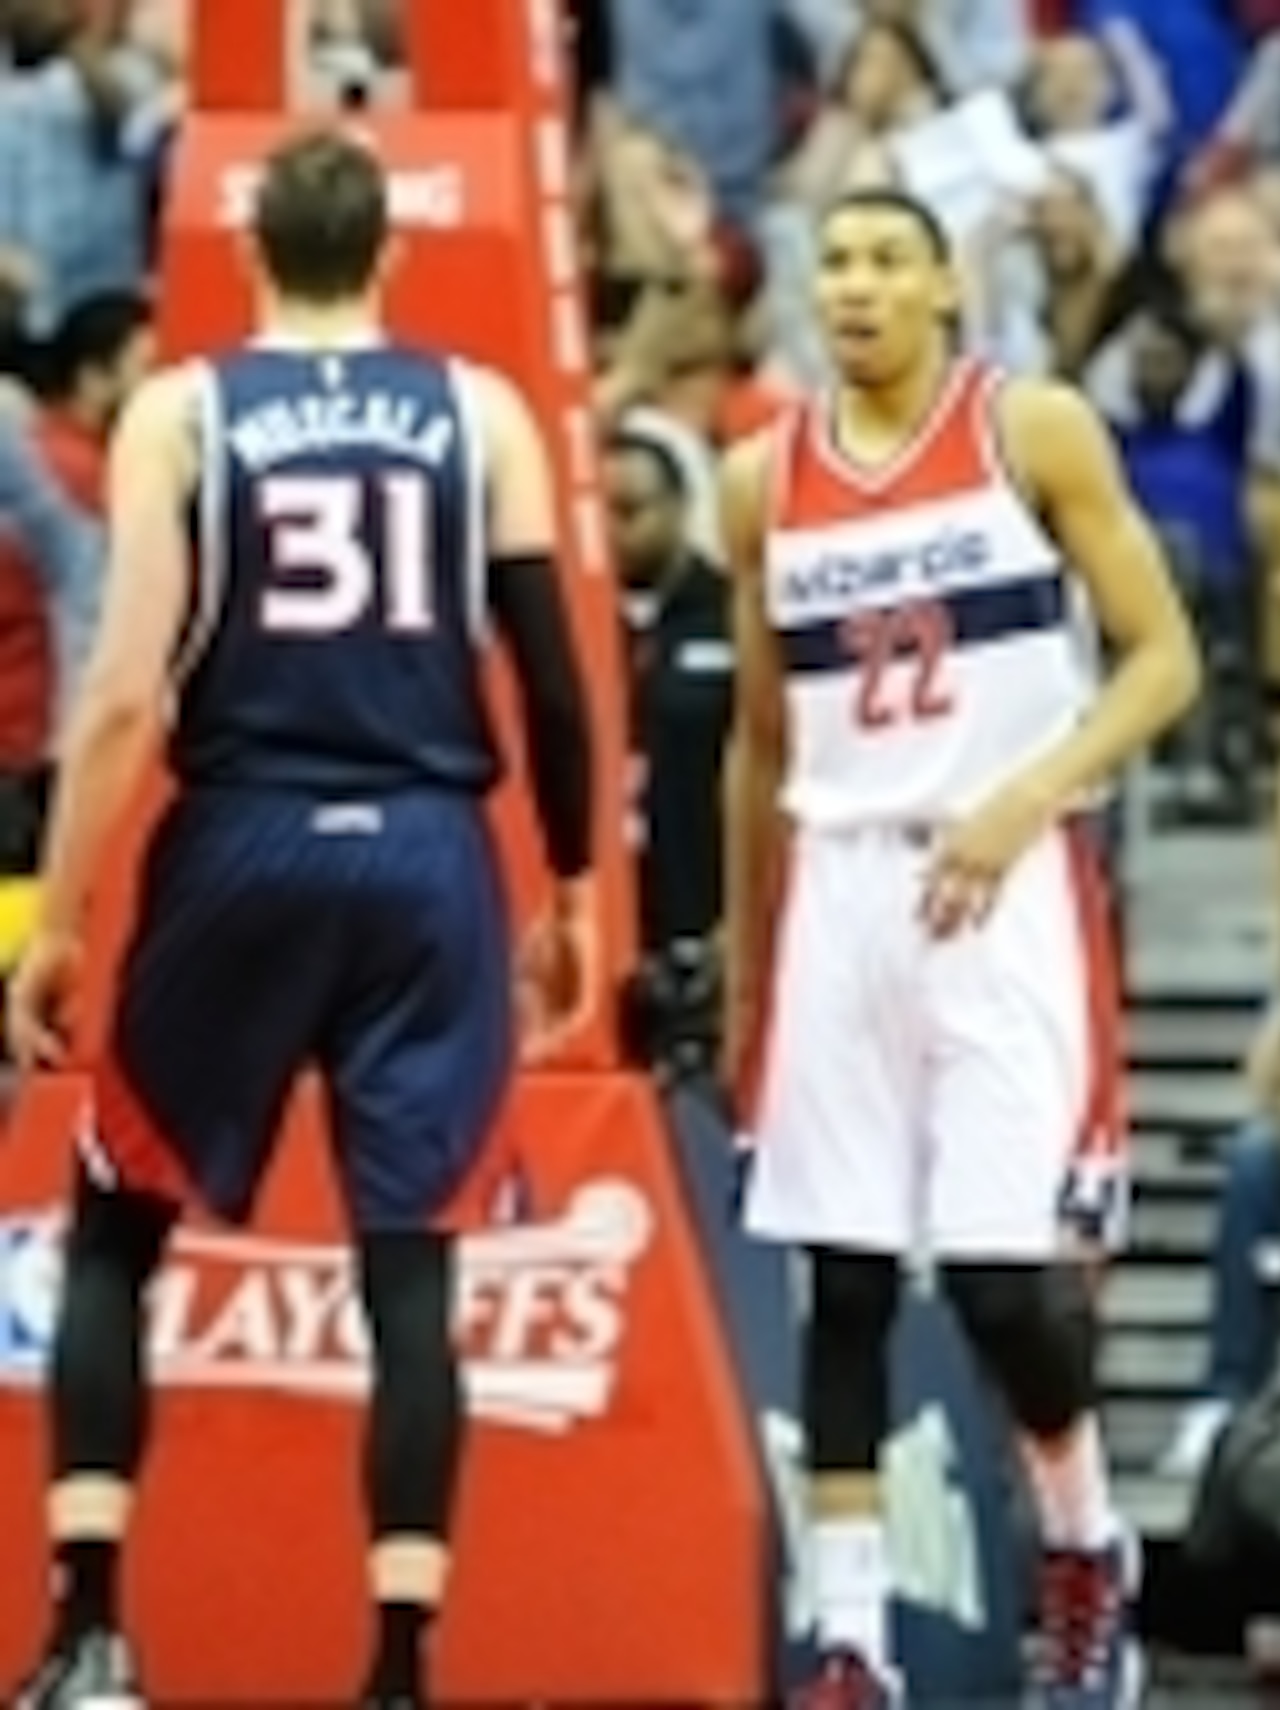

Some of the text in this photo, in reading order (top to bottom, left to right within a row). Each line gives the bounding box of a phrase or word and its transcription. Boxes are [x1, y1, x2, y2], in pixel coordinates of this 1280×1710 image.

[258, 474, 436, 631] 31
[842, 600, 953, 726] 22
[140, 1266, 629, 1357] LAYFFS
